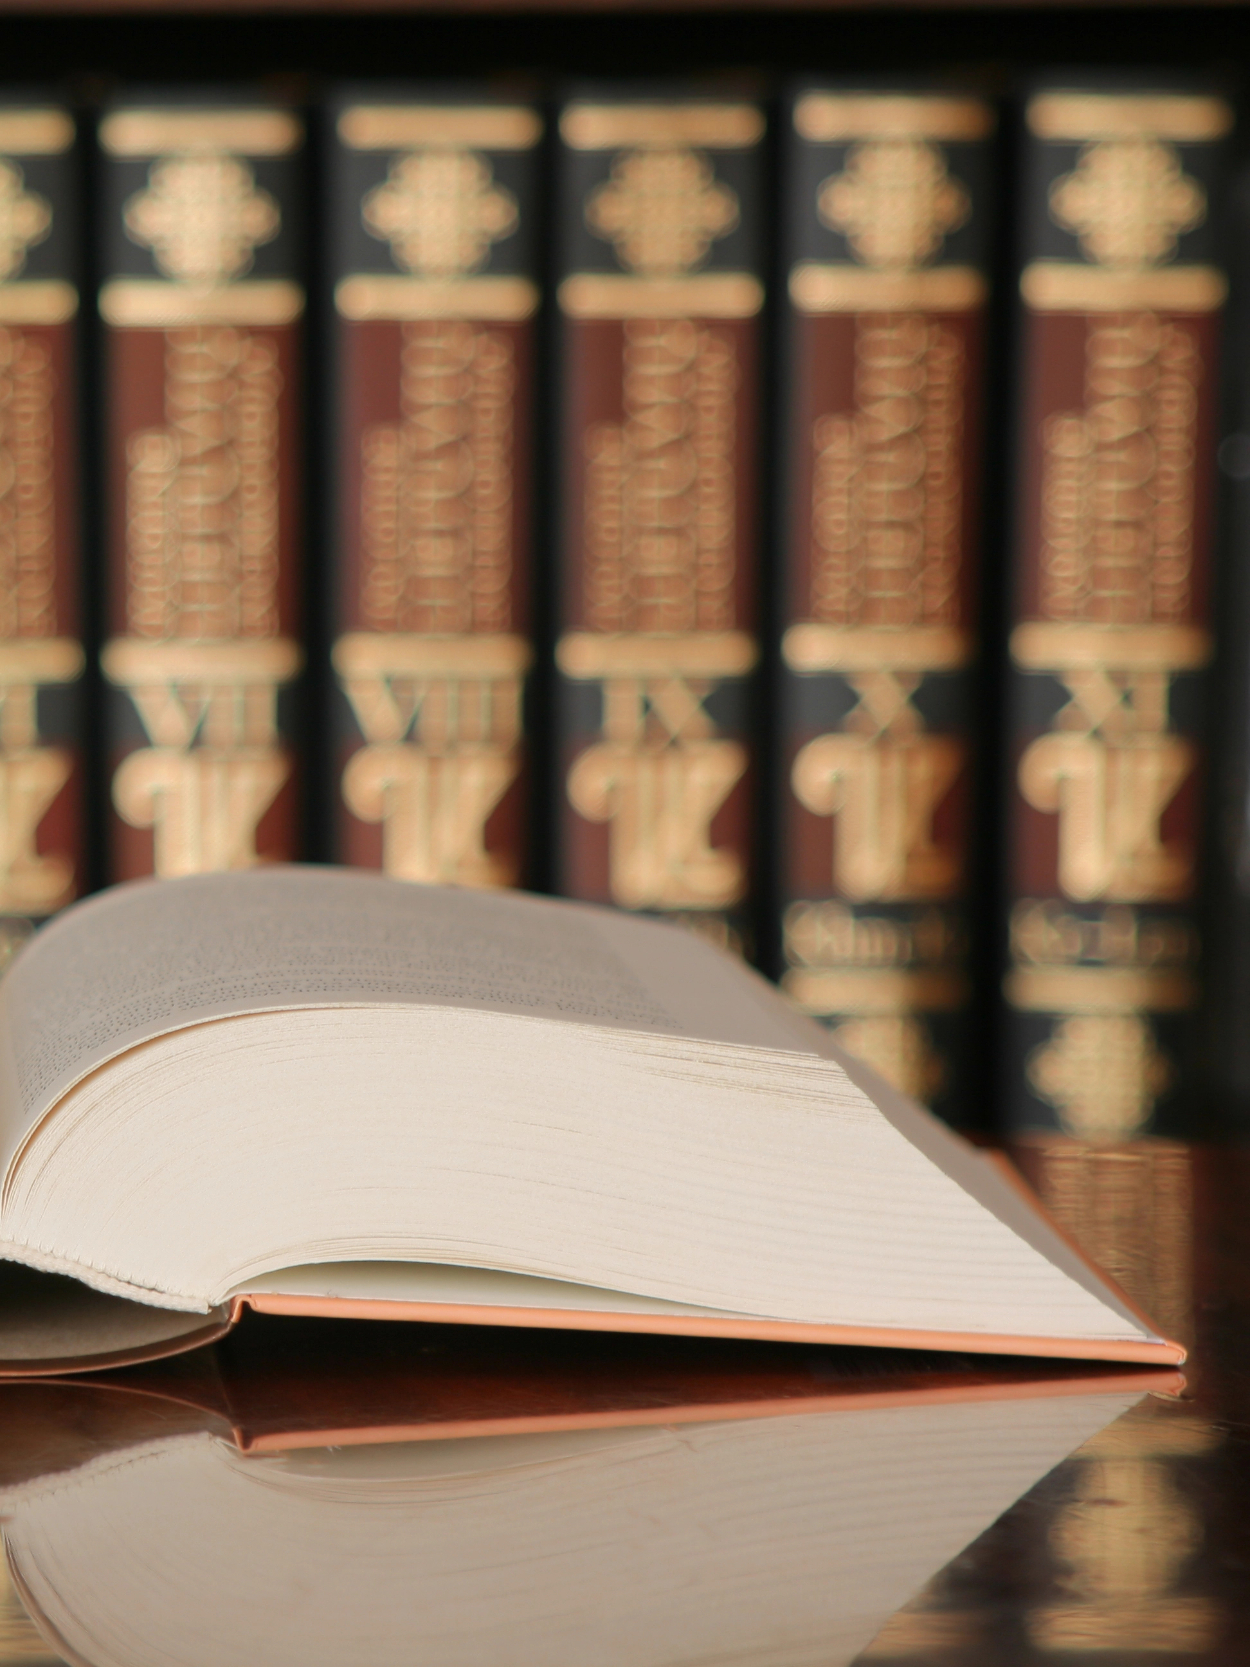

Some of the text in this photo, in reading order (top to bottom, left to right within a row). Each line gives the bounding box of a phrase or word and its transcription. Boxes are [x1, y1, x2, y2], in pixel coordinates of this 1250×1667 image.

[126, 680, 278, 750] VII
[600, 672, 718, 748] IX
[840, 668, 930, 746] X
[1052, 666, 1170, 742] XI
